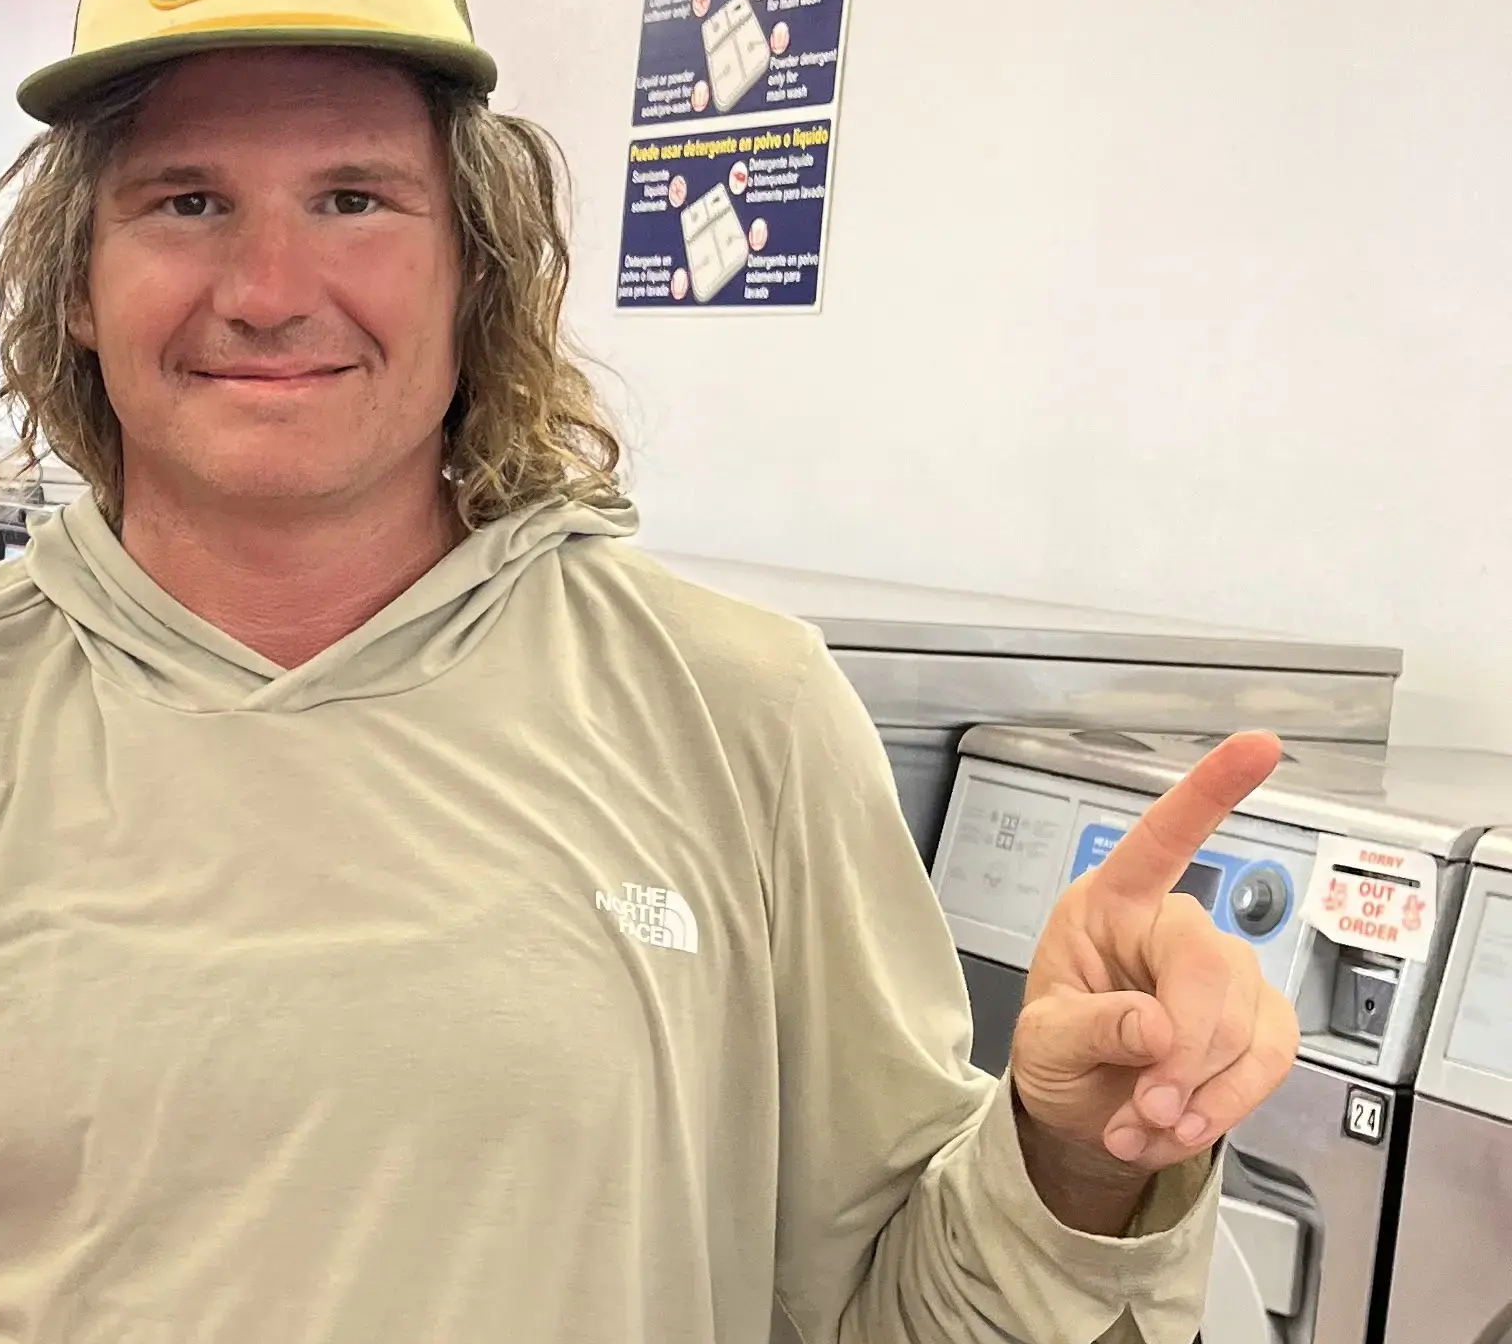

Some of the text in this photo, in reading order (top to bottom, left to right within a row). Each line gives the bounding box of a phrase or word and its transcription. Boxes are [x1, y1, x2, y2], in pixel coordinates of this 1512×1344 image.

[800, 48, 836, 66] detergent
[630, 143, 659, 162] Puede
[661, 145, 682, 159] usar
[684, 136, 737, 159] detergente
[739, 137, 752, 152] en
[753, 131, 781, 155] polvo
[783, 133, 791, 148] o
[749, 157, 787, 173] Detergente
[748, 254, 786, 270] Detergente
[1359, 850, 1404, 868] SORRY
[621, 882, 666, 908] THE
[1359, 881, 1396, 901] OUT
[1362, 901, 1385, 918] OF
[1338, 916, 1399, 942] ORDER
[1354, 1103, 1376, 1132] 24
